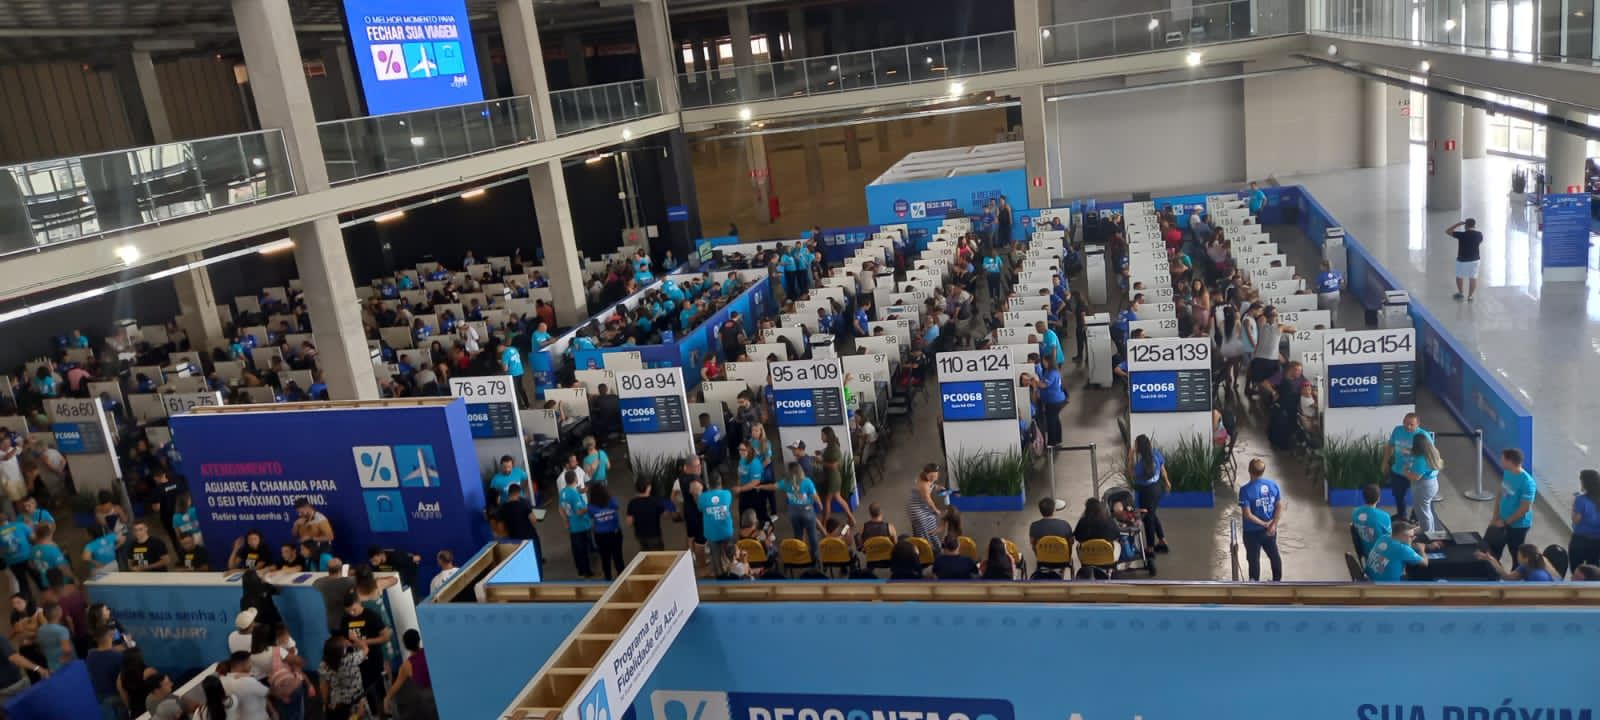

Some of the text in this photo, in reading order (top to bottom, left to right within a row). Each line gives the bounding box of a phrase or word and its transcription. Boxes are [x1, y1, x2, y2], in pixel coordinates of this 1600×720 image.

[364, 15, 371, 23] O
[372, 15, 403, 24] MELHOR
[404, 15, 437, 23] MOMENTO
[366, 25, 458, 40] FECHAR SUA VIAGEM
[1246, 257, 1260, 265] 147
[1154, 263, 1169, 271] 132
[1019, 271, 1032, 280] 117
[1252, 269, 1268, 277] 146
[1154, 275, 1169, 283] 131
[1260, 282, 1277, 290] 145
[1156, 289, 1172, 297] 130
[1010, 298, 1024, 306] 115
[1269, 297, 1287, 305] 144
[1158, 303, 1174, 312] 129
[1005, 312, 1019, 320] 114
[1279, 313, 1298, 322] 143
[1159, 320, 1177, 329] 128
[999, 328, 1015, 337] 113
[1291, 331, 1311, 341] 142
[885, 335, 897, 344] 98
[874, 354, 886, 363] 97
[1303, 352, 1324, 363] 141
[726, 363, 737, 372] 82
[939, 353, 1011, 374] 110 a 124
[772, 363, 838, 383] 95 a 109
[621, 372, 676, 391] 80 a 94
[859, 373, 872, 383] 96
[1331, 375, 1378, 388] PC0068
[454, 380, 506, 398] 76 a 79
[703, 383, 714, 391] 81
[1132, 381, 1175, 393] PC0068
[575, 389, 585, 397] 77
[943, 392, 983, 403] PC0068
[169, 398, 183, 412] 61
[776, 399, 812, 410] PC0068
[621, 407, 656, 418] PC0068
[205, 479, 337, 493] AGUARDE A CHAMADA PARA
[207, 495, 215, 507] O
[217, 495, 236, 507] SEU
[237, 493, 281, 507] PRÓXIMO
[417, 501, 440, 512] Azul
[613, 608, 660, 675] Programa de
[617, 600, 679, 693] Fidelidade da Azul
